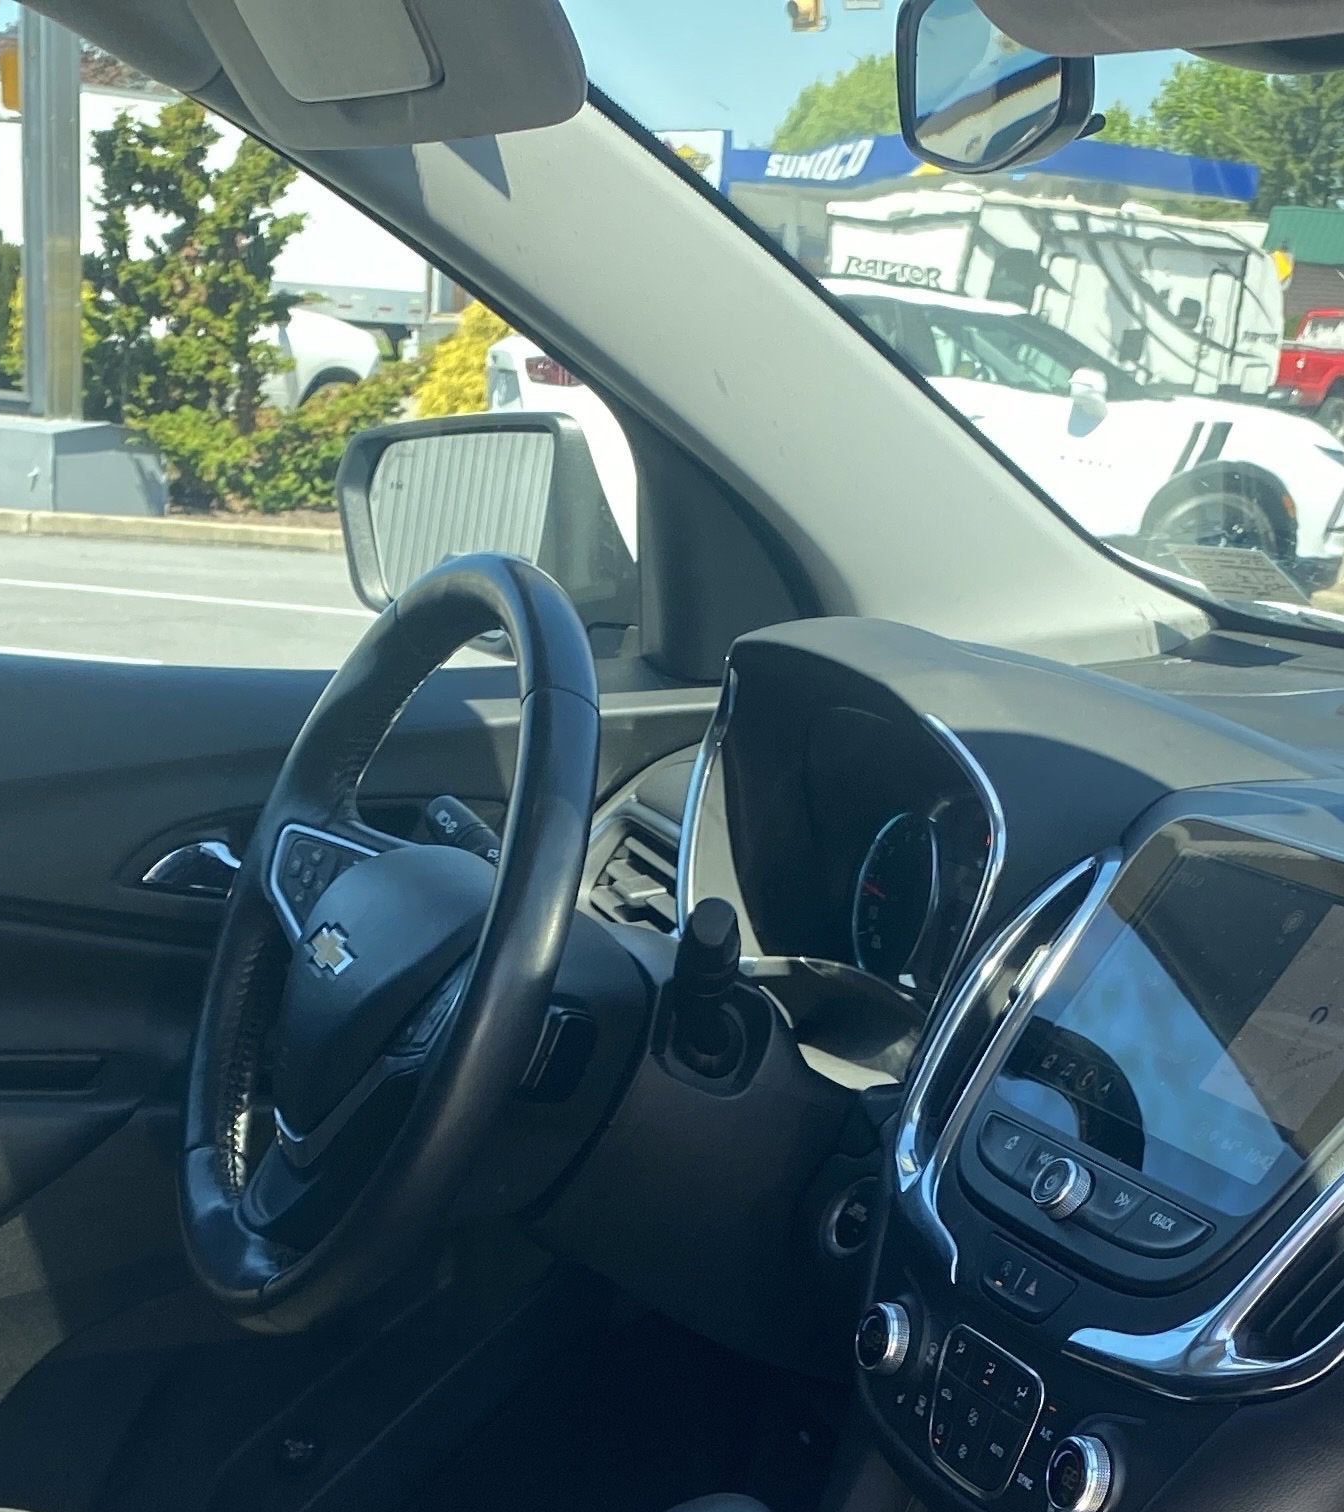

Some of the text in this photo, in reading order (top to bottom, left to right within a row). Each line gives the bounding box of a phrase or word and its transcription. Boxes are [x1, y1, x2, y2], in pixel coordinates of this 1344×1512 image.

[764, 139, 875, 182] SUNOCO
[844, 255, 942, 290] RAPTOR
[1152, 1212, 1177, 1232] BACK
